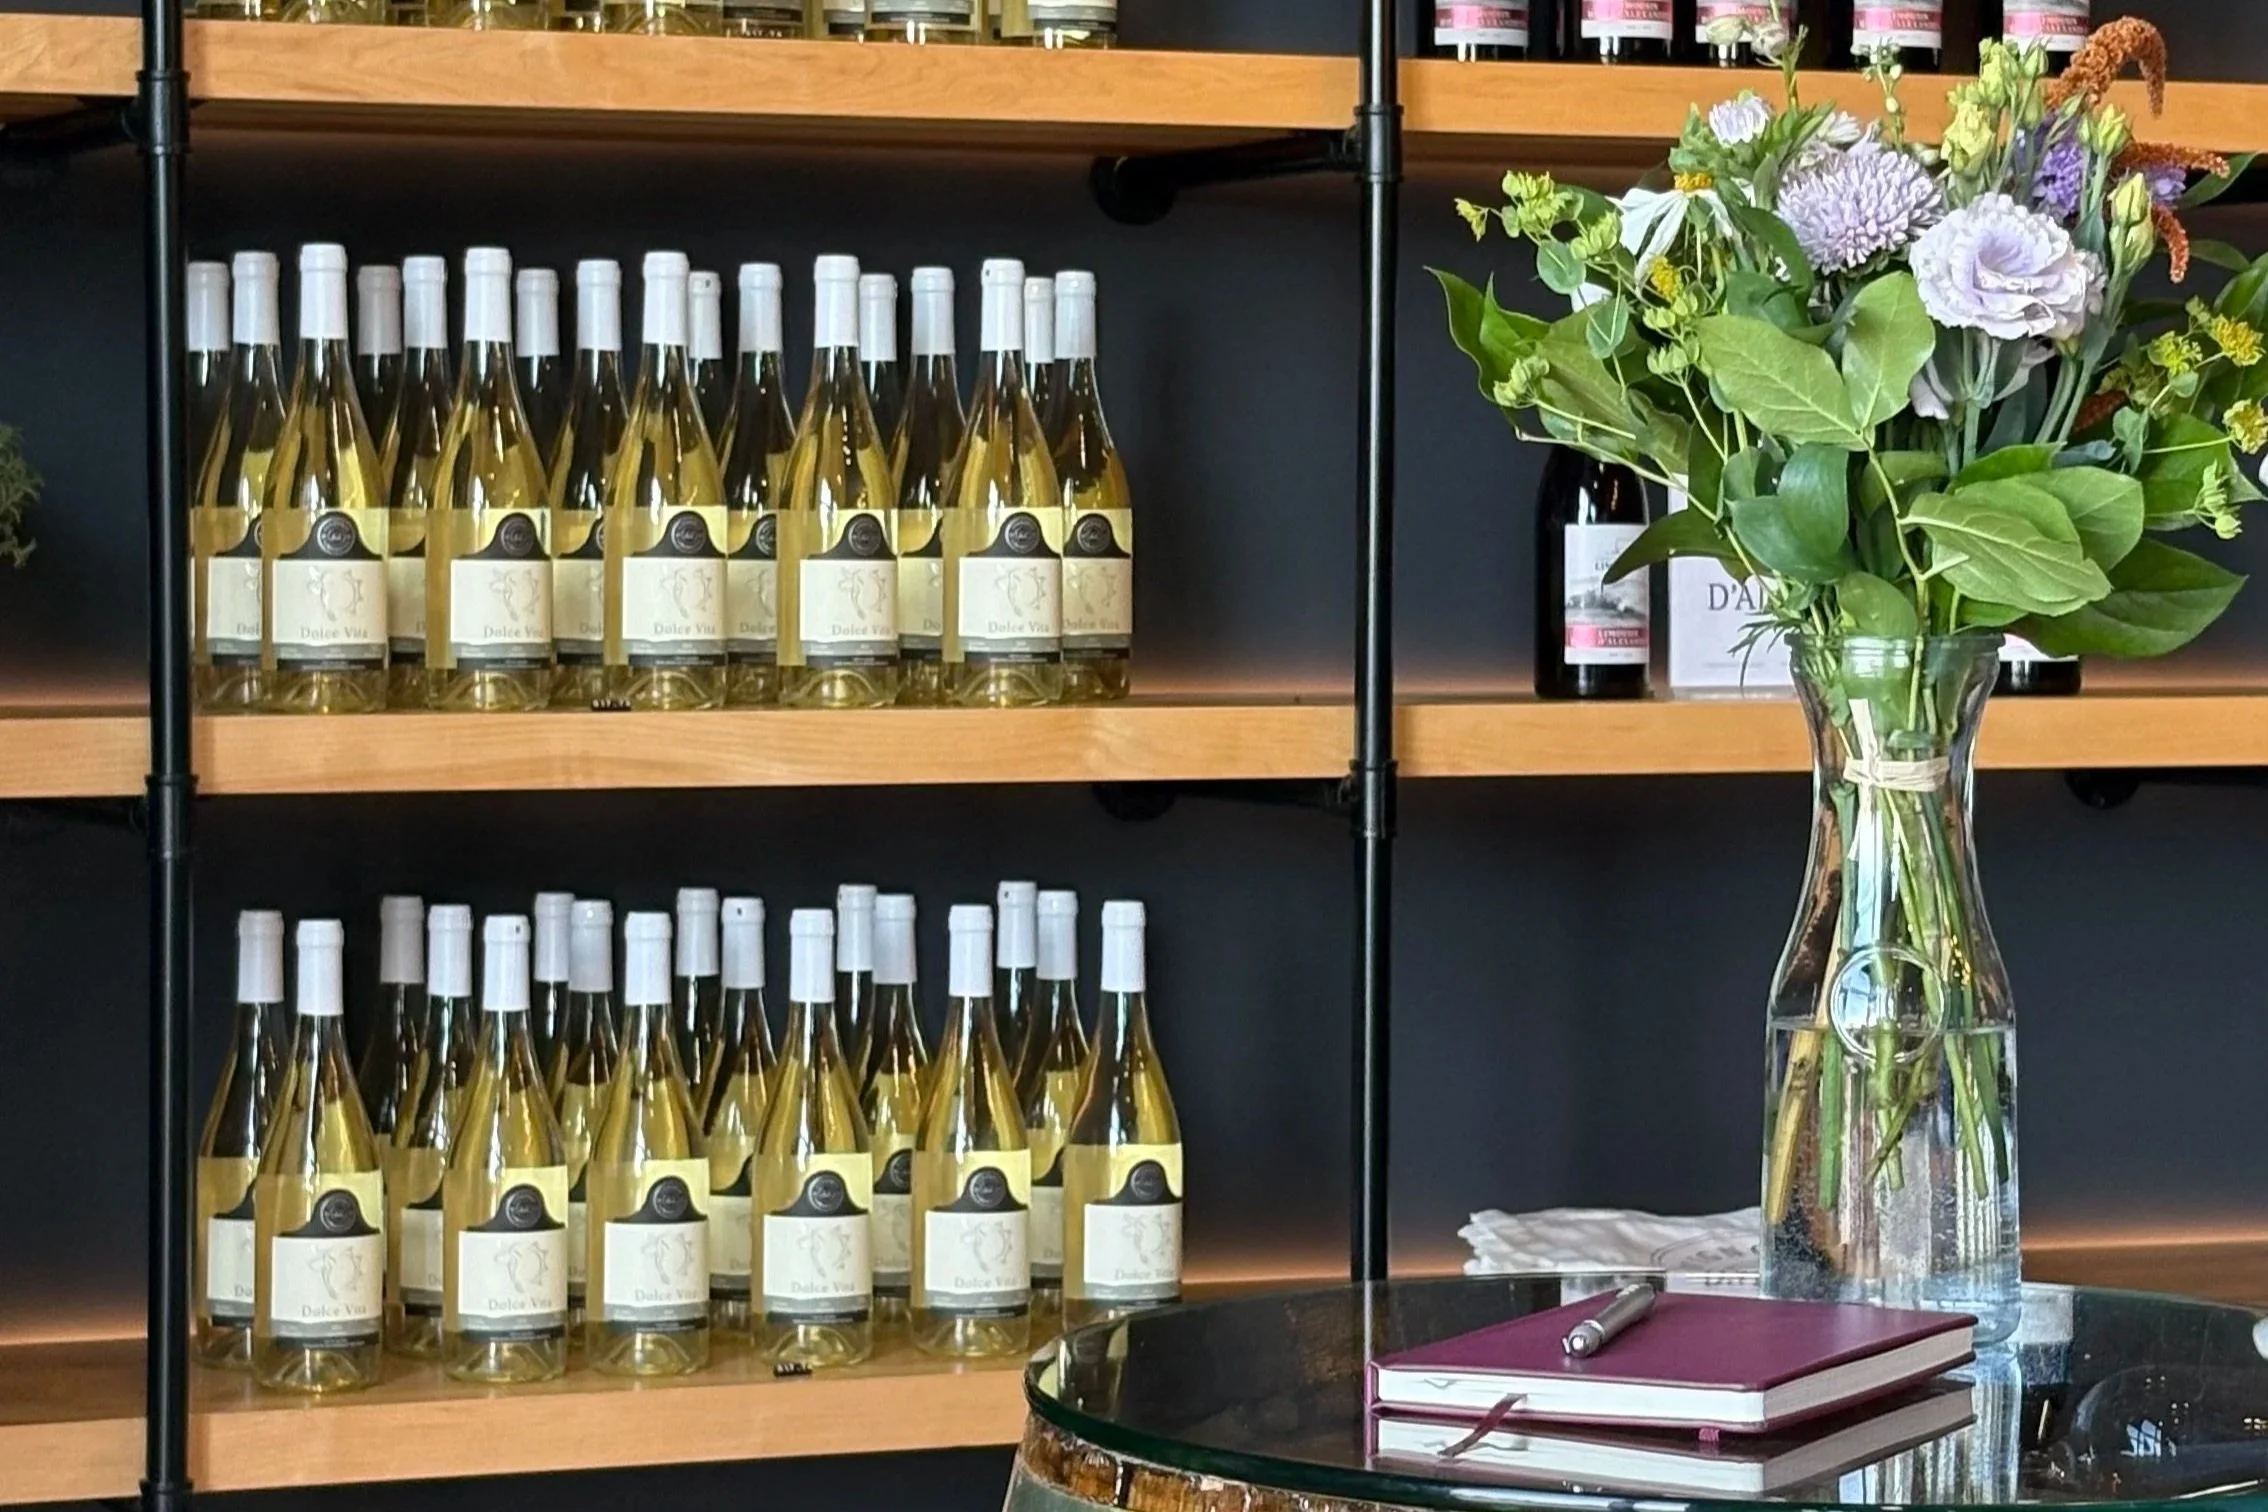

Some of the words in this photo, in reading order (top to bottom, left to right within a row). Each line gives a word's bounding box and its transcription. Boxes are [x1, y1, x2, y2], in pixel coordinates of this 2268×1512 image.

[301, 625, 339, 639] Dolce
[344, 626, 368, 639] Vita
[484, 625, 522, 639] Dolce
[654, 621, 692, 635] Dolce
[832, 623, 868, 637] Dolce
[988, 621, 1025, 633] Dolce
[1028, 621, 1049, 633] Vita
[1115, 1268, 1151, 1281] Dolce
[791, 1281, 829, 1294] Dolce
[954, 1276, 992, 1289] Dolce
[634, 1289, 672, 1302] Dolce
[301, 1304, 339, 1318] Dolce
[488, 1298, 526, 1312] Dolce
